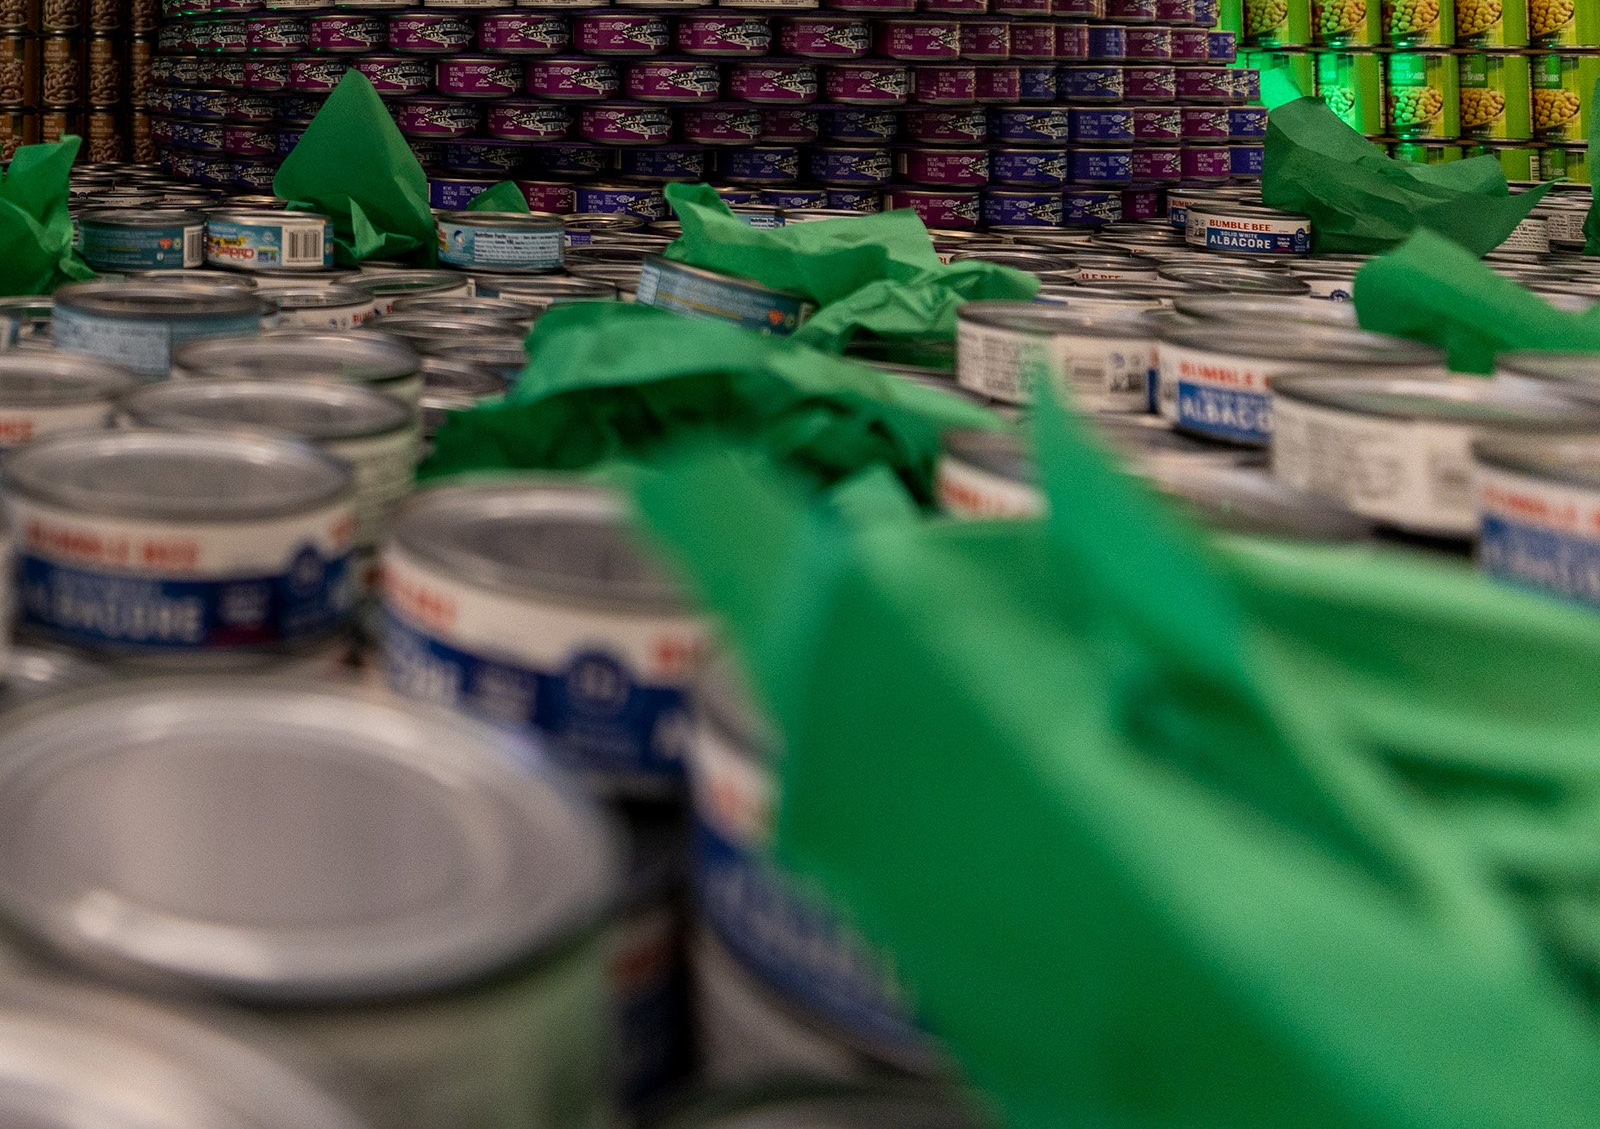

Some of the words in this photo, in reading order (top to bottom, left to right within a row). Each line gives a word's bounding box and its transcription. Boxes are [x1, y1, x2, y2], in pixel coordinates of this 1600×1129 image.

[1209, 219, 1250, 231] BUMBLE
[1252, 223, 1271, 232] BEE
[1209, 235, 1271, 249] ALBACORE
